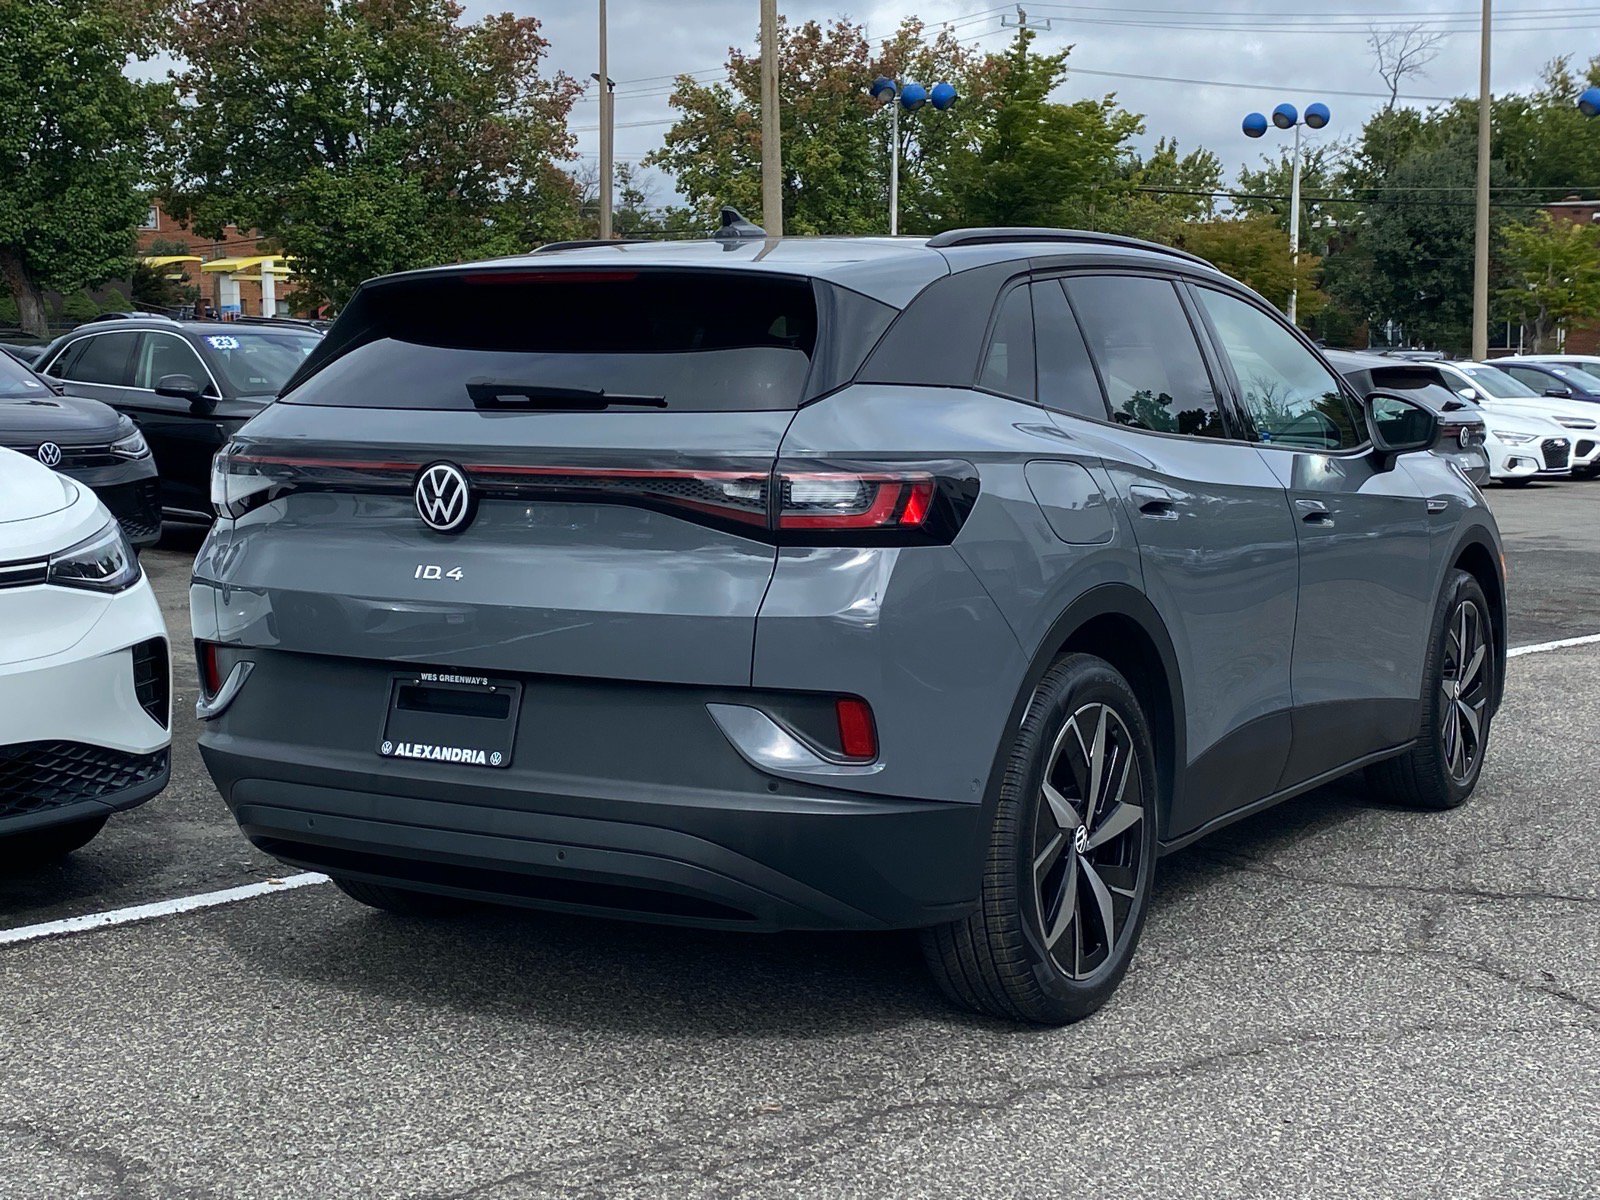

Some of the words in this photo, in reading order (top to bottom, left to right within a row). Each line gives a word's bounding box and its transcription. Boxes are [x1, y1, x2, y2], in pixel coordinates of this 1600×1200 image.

[216, 338, 232, 346] 23
[38, 442, 61, 467] VW
[416, 465, 468, 530] VW
[421, 672, 437, 681] WES
[439, 674, 488, 685] GREENWAY'S
[394, 743, 486, 764] ALEXANDRIA
